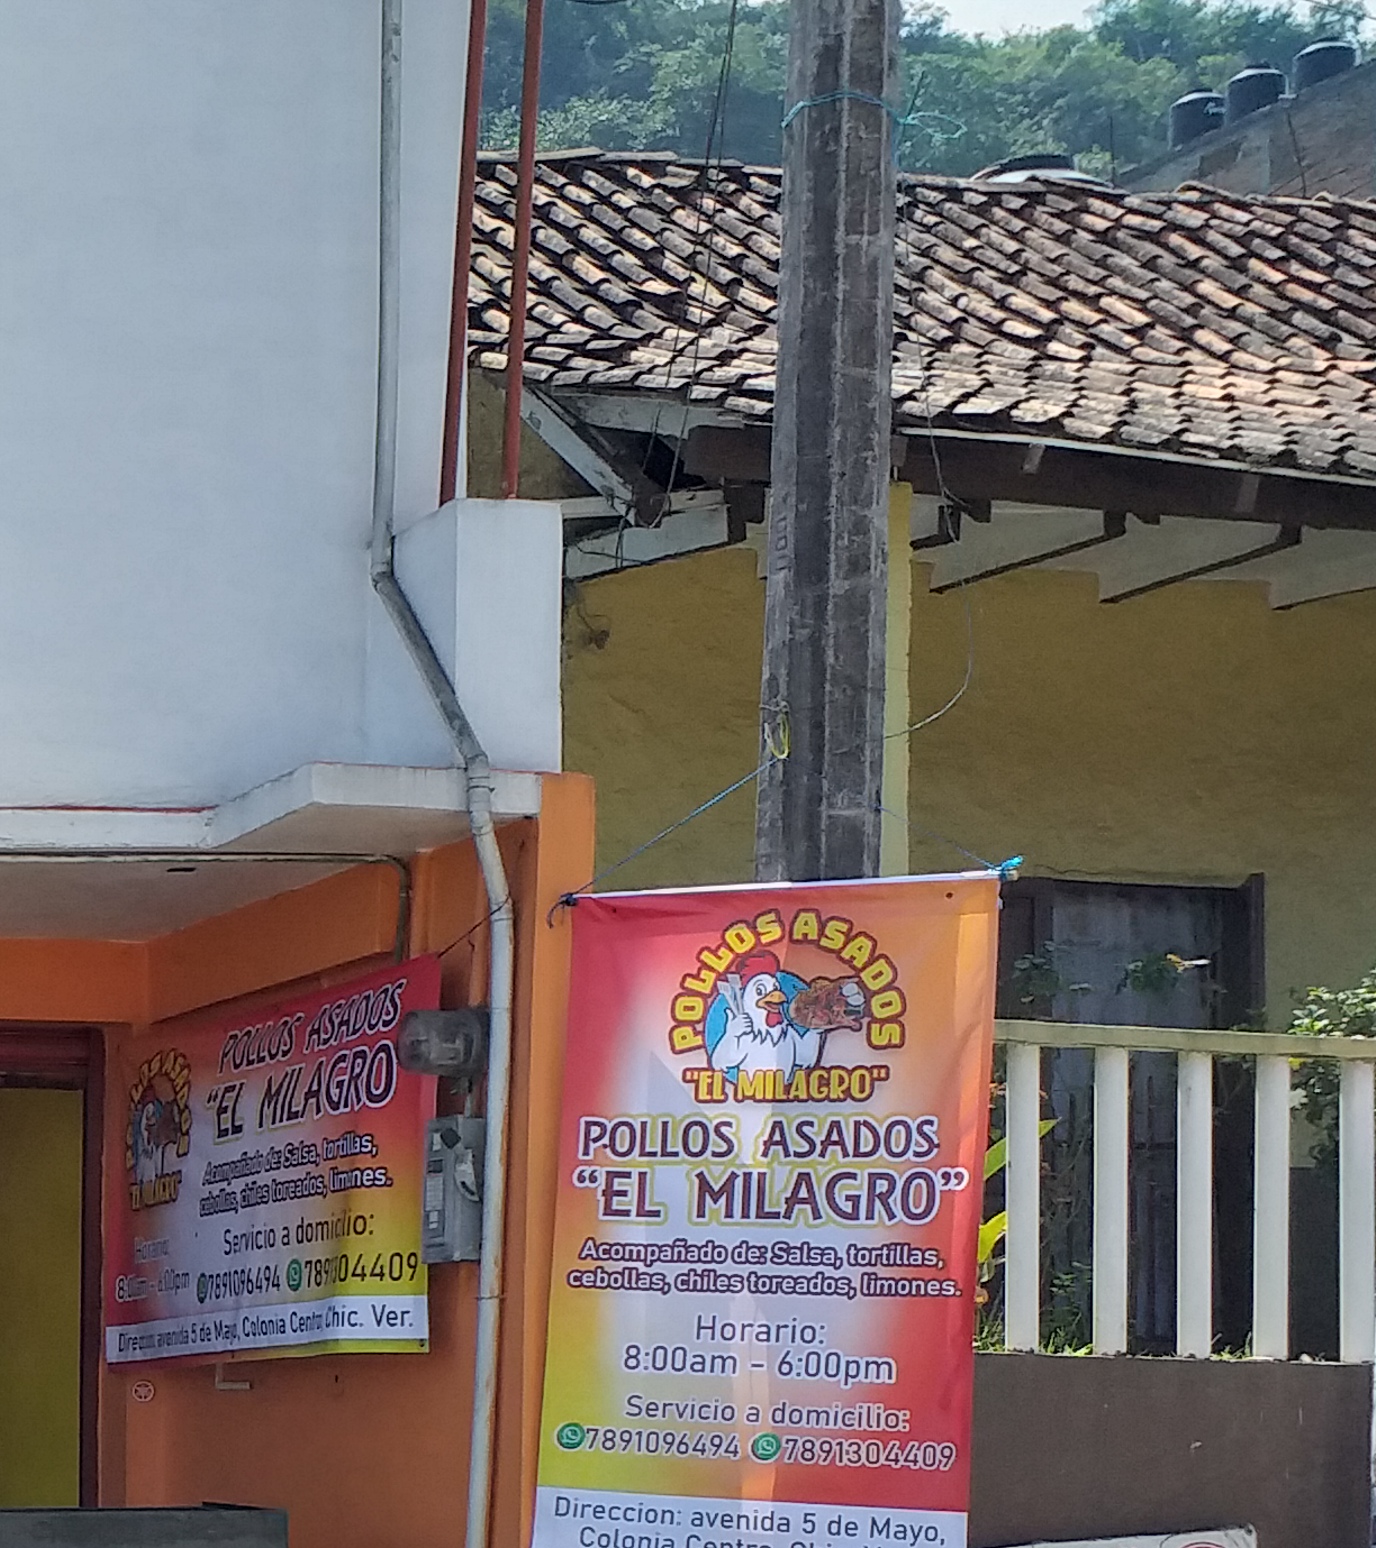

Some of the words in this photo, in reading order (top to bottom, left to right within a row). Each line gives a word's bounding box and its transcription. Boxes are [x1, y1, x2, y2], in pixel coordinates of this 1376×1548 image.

[668, 908, 784, 1055] POLLOS
[790, 908, 908, 1050] ASADOS
[218, 1012, 303, 1077] POLLOS
[303, 978, 407, 1055] ASADOS
[283, 1139, 320, 1166] Salsa,
[322, 1132, 377, 1159] tortillas,
[580, 1117, 736, 1161] POLLOS
[761, 1117, 940, 1161] ASADOS
[271, 1172, 327, 1202] toreados,
[223, 1223, 276, 1257] Servicio
[281, 1227, 291, 1245] a
[579, 1238, 728, 1266] Acompañado
[732, 1243, 769, 1265] de:
[770, 1241, 843, 1270] Salsa,
[847, 1245, 945, 1271] tortillas,
[207, 1264, 281, 1301] 7891096494
[304, 1251, 418, 1290] 78904409
[567, 1269, 671, 1296] cebollas,
[675, 1273, 745, 1294] chiles
[747, 1274, 857, 1300] toreados,
[861, 1275, 963, 1299] limones.
[190, 1321, 198, 1343] 5
[199, 1318, 212, 1341] de
[242, 1312, 287, 1337] Colonia
[325, 1304, 364, 1328] Chic.
[371, 1303, 414, 1328] Ver.
[695, 1314, 826, 1345] Horario:
[623, 1345, 737, 1376] 8:00am
[777, 1350, 895, 1385] 6:00pm
[625, 1395, 736, 1423] Servicio
[746, 1406, 761, 1423] a
[771, 1402, 911, 1430] domicilio:
[586, 1427, 740, 1459] 7891096494
[783, 1437, 956, 1470] 7891304409
[554, 1497, 684, 1527] Direccion:
[690, 1508, 791, 1535] avenida
[802, 1513, 817, 1535] 5
[826, 1514, 859, 1537] de
[869, 1517, 947, 1546] Mayo,
